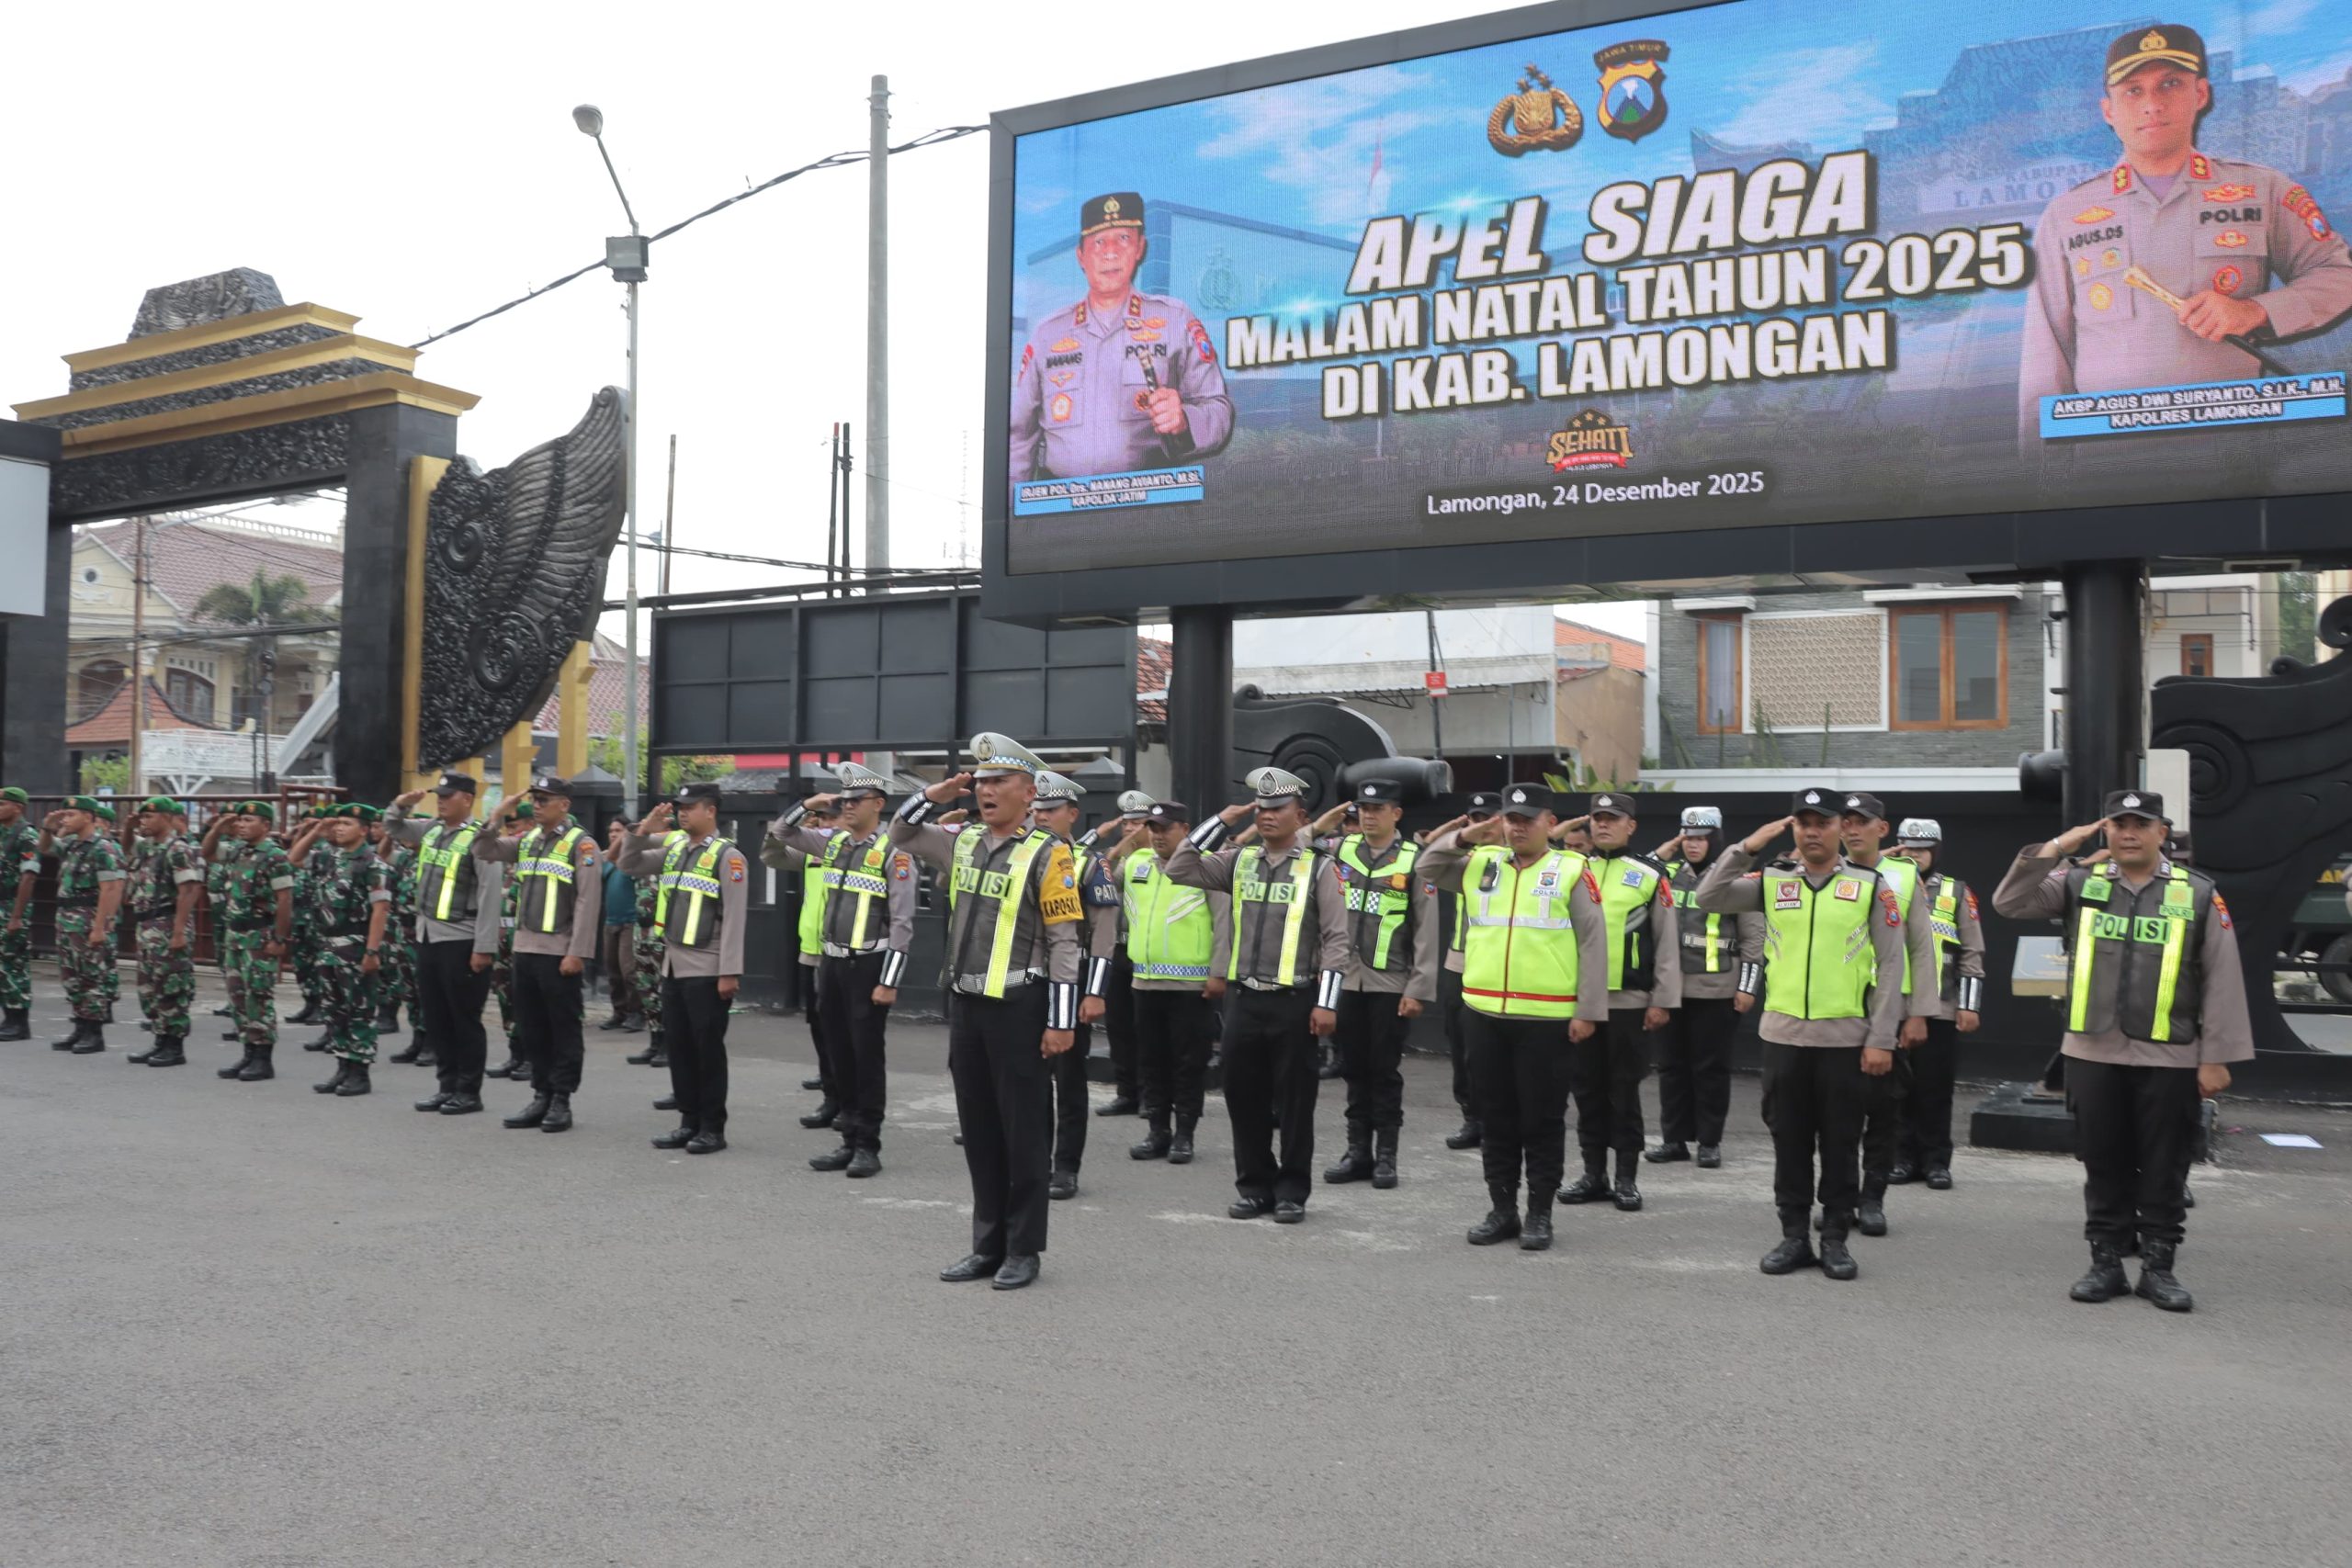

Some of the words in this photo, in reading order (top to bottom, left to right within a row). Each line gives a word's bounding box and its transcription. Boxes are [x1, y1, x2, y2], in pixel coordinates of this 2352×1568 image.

[1347, 197, 1544, 294] APEL
[1584, 151, 1868, 263] SIAGA
[2200, 208, 2261, 224] POLRI
[1227, 295, 1419, 367] MALAM
[1433, 273, 1606, 344] NATAL
[1619, 248, 1826, 321] TAHUN
[1843, 225, 2024, 300] 2025
[1322, 362, 1378, 419] DI
[1395, 350, 1525, 411] KAB.
[1539, 310, 1888, 398] LAMONGAN
[2054, 400, 2095, 414] AKBP
[2097, 395, 2139, 411] AGUS
[2142, 392, 2170, 407] DWI
[2110, 407, 2190, 427] KAPOLRES
[2194, 401, 2282, 421] LAMONGAN
[1546, 427, 1634, 464] SEHATI
[1428, 490, 1547, 514] Lamongan,
[1553, 485, 1579, 506] 24
[1586, 477, 1702, 504] Desember
[1707, 471, 1765, 496] 2025
[1238, 882, 1296, 901] POLISI
[2093, 913, 2168, 942] POLISI
